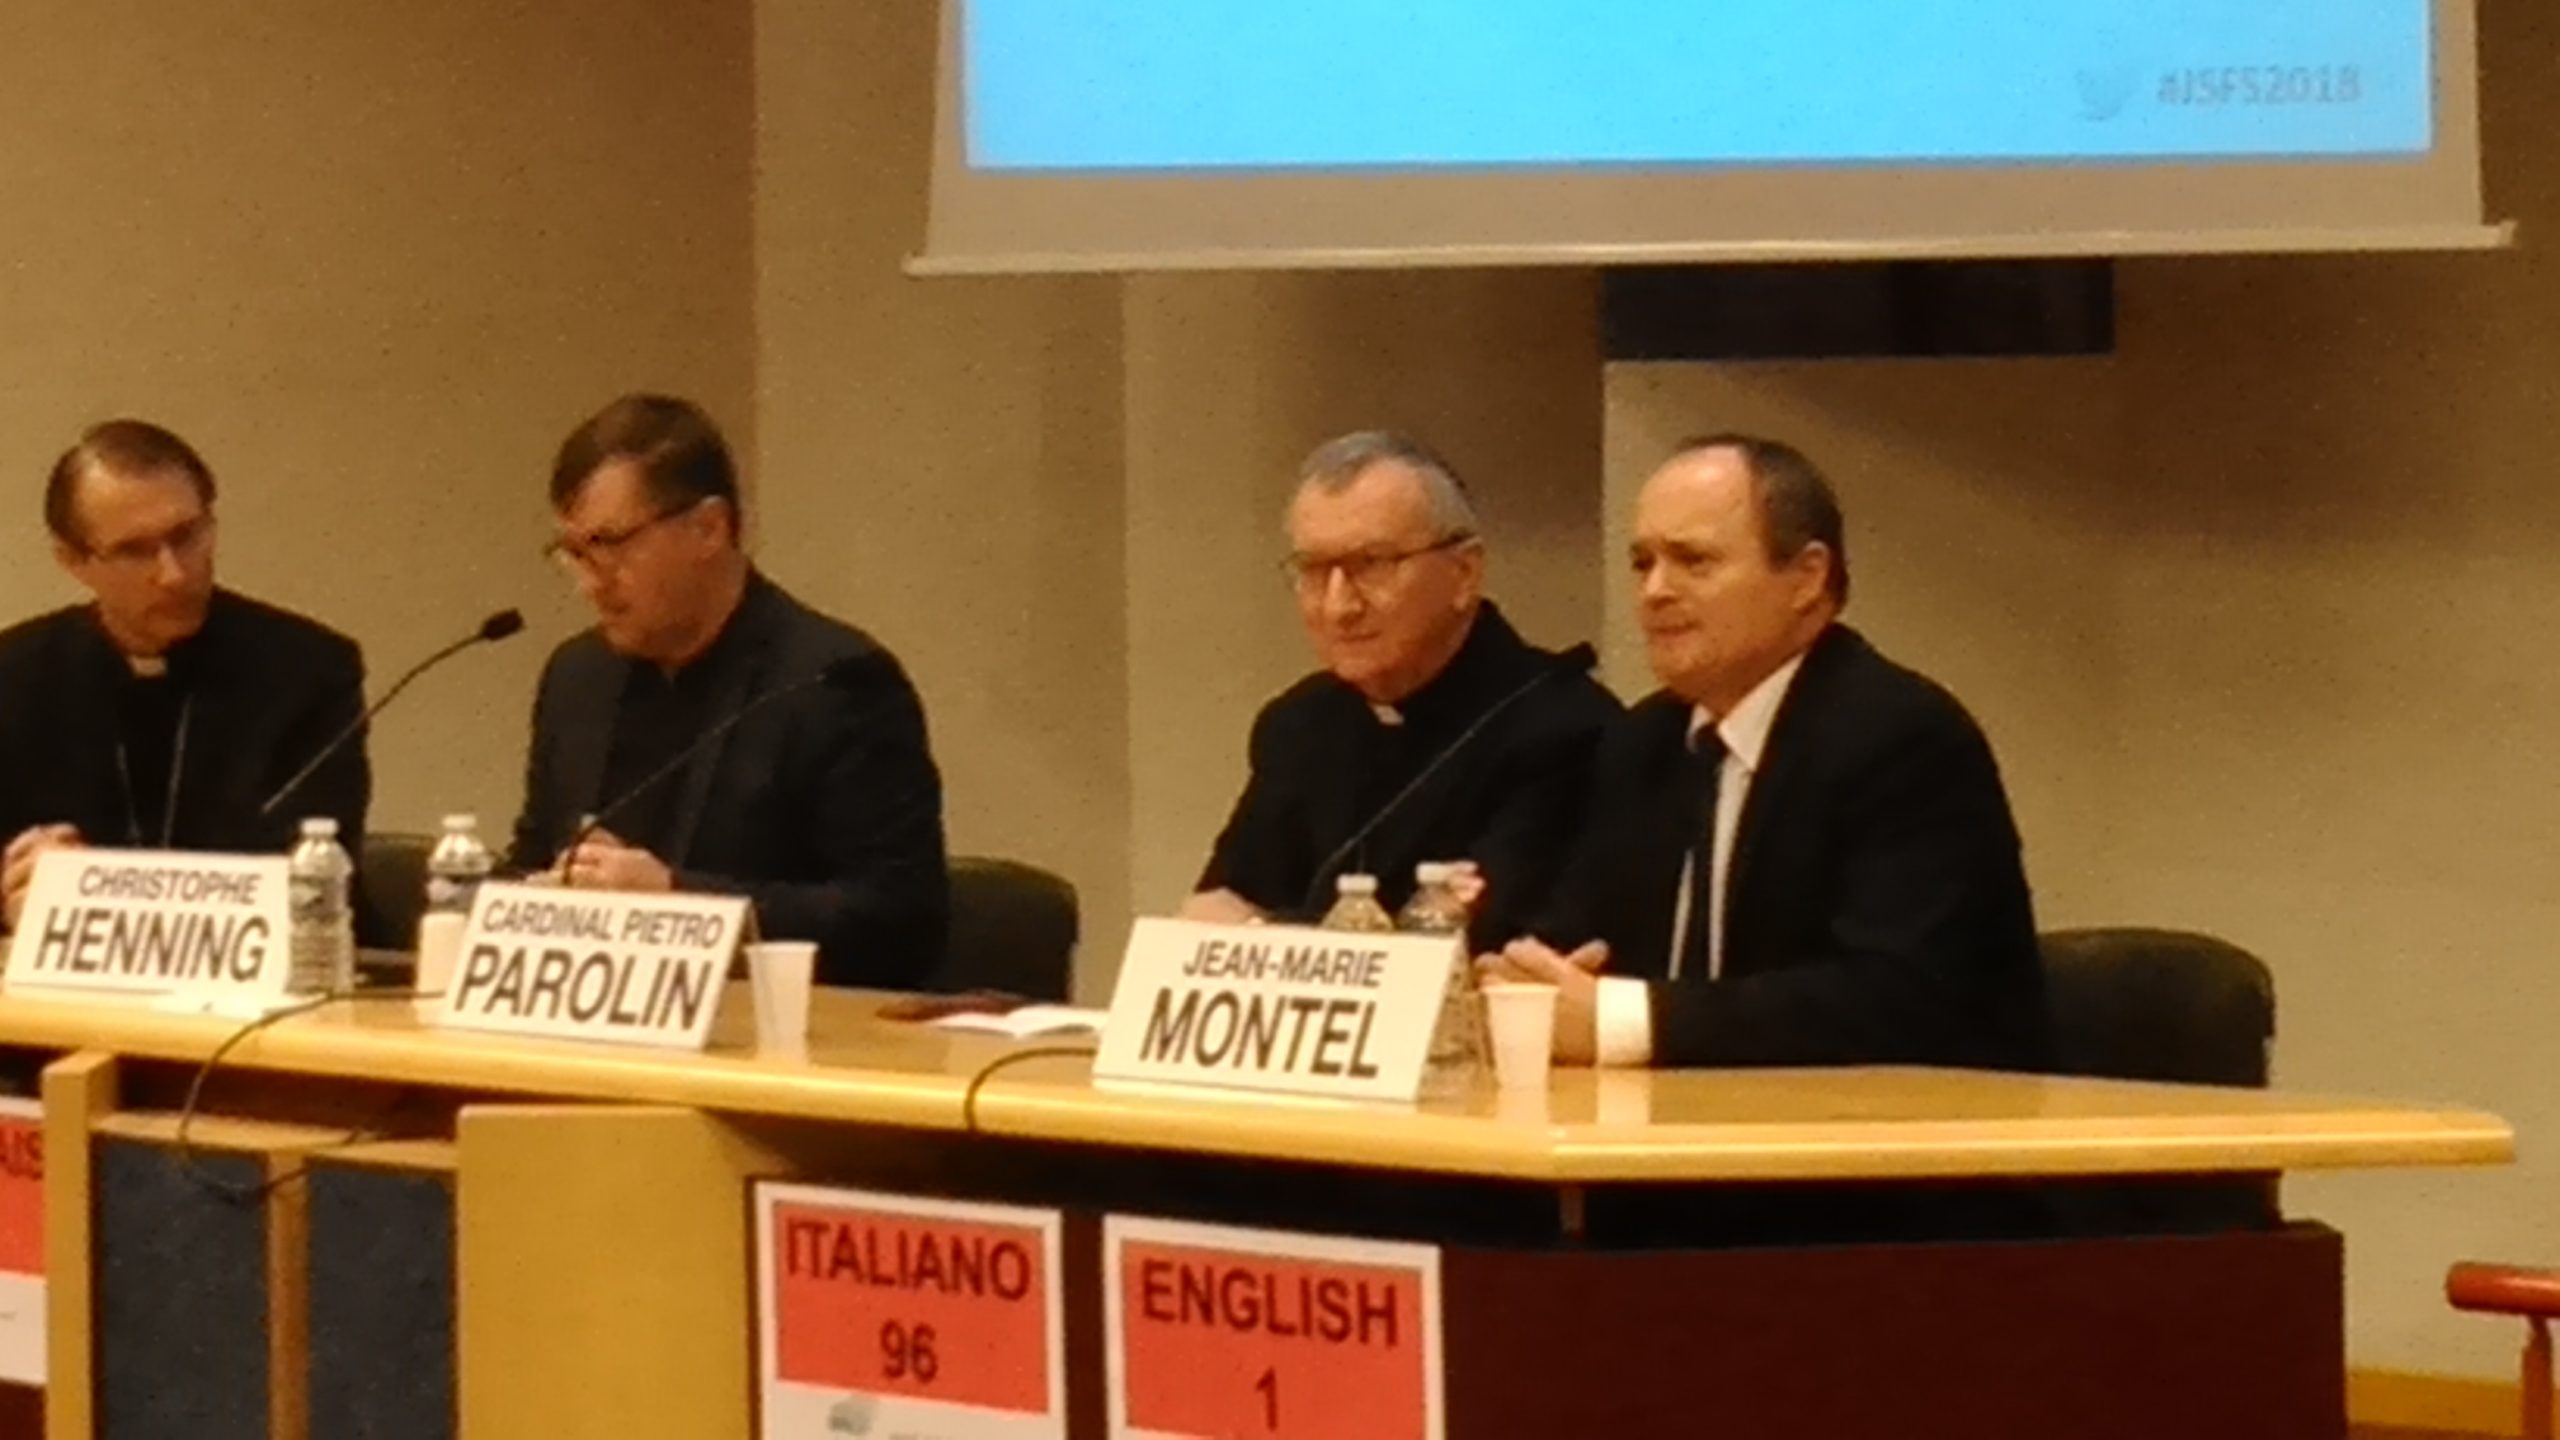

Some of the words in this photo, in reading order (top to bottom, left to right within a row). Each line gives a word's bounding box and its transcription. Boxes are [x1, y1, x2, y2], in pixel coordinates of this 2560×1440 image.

[78, 865, 262, 905] CHRISTOPHE
[33, 906, 269, 983] HENNING
[482, 900, 614, 941] CARDINAL
[621, 909, 725, 949] PIETRO
[454, 945, 712, 1030] PAROLIN
[1183, 941, 1388, 988] JEAN-MARIE
[1139, 987, 1380, 1079] MONTEL
[786, 1219, 1031, 1301] ITALIANO
[1141, 1260, 1399, 1348] ENGLISH
[879, 1321, 939, 1384] 96
[1255, 1367, 1279, 1433] 1
